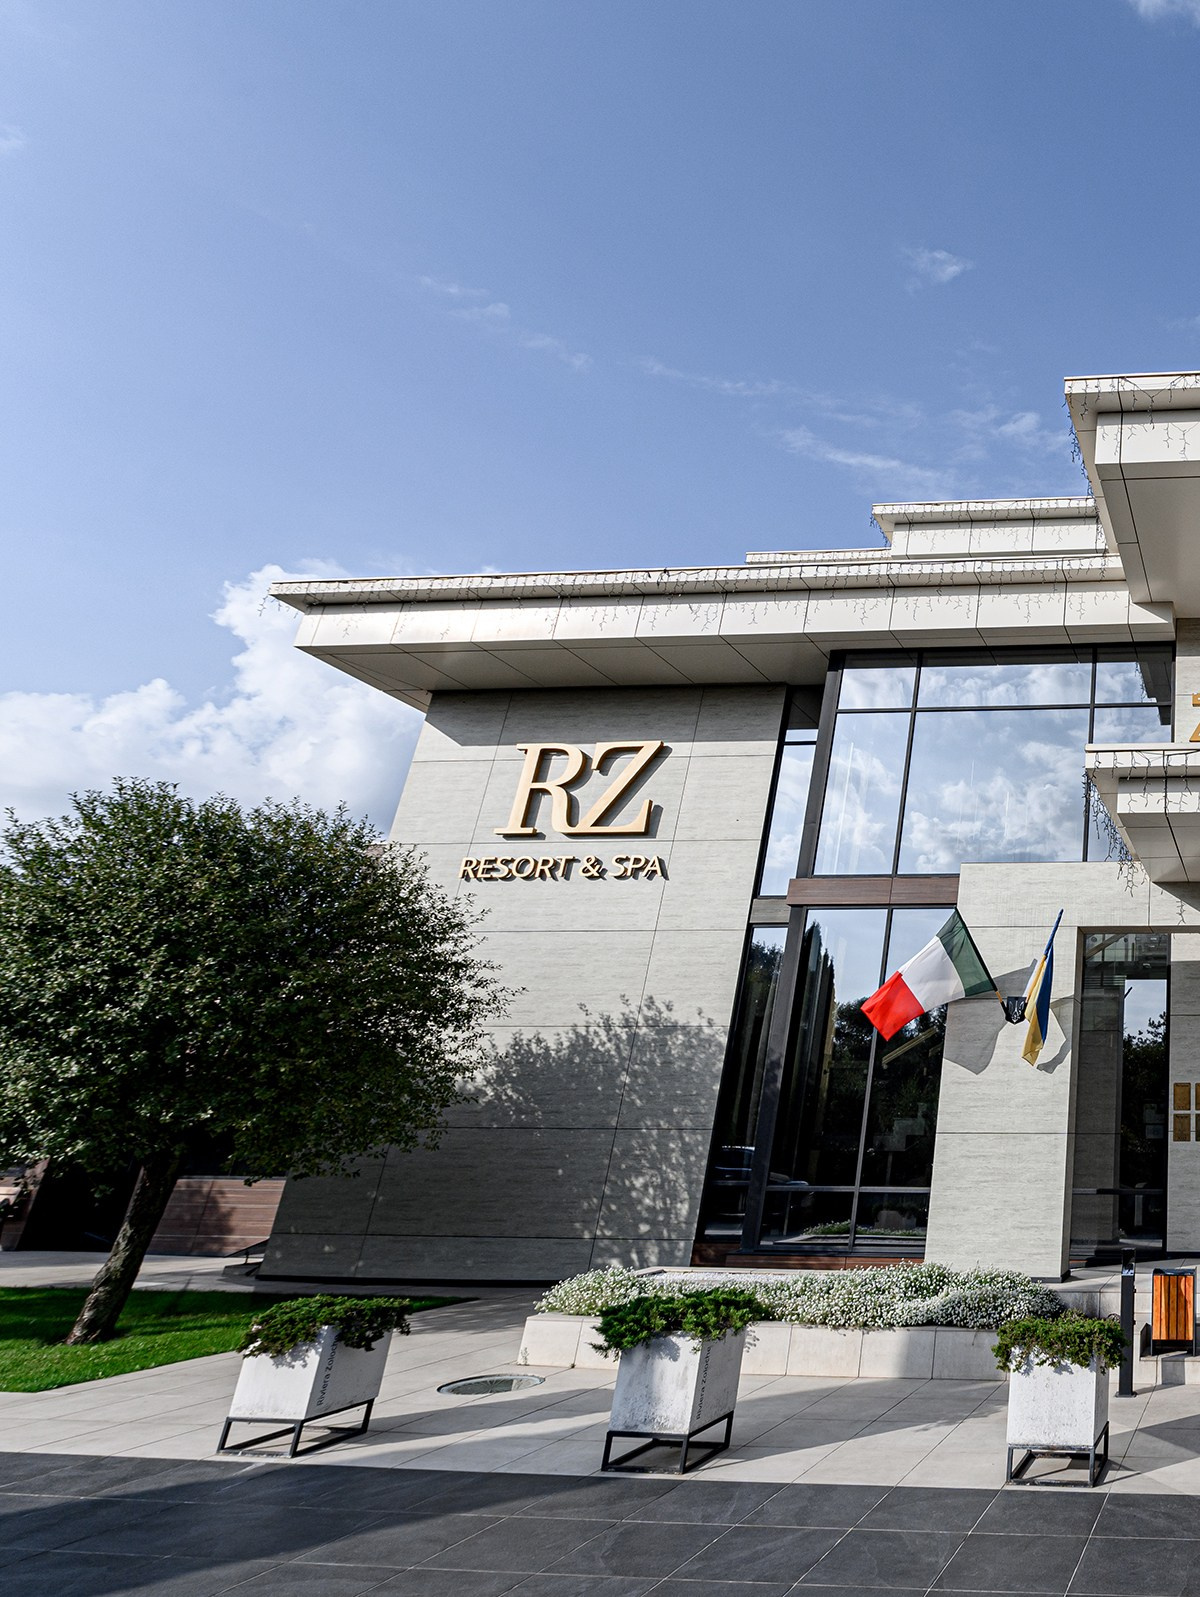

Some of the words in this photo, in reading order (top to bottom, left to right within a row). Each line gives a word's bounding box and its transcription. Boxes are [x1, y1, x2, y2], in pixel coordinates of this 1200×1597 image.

[494, 740, 665, 835] RZ
[458, 856, 575, 879] RESORT
[578, 855, 603, 877] &
[609, 854, 664, 878] SPA
[317, 1373, 331, 1406] Riviera
